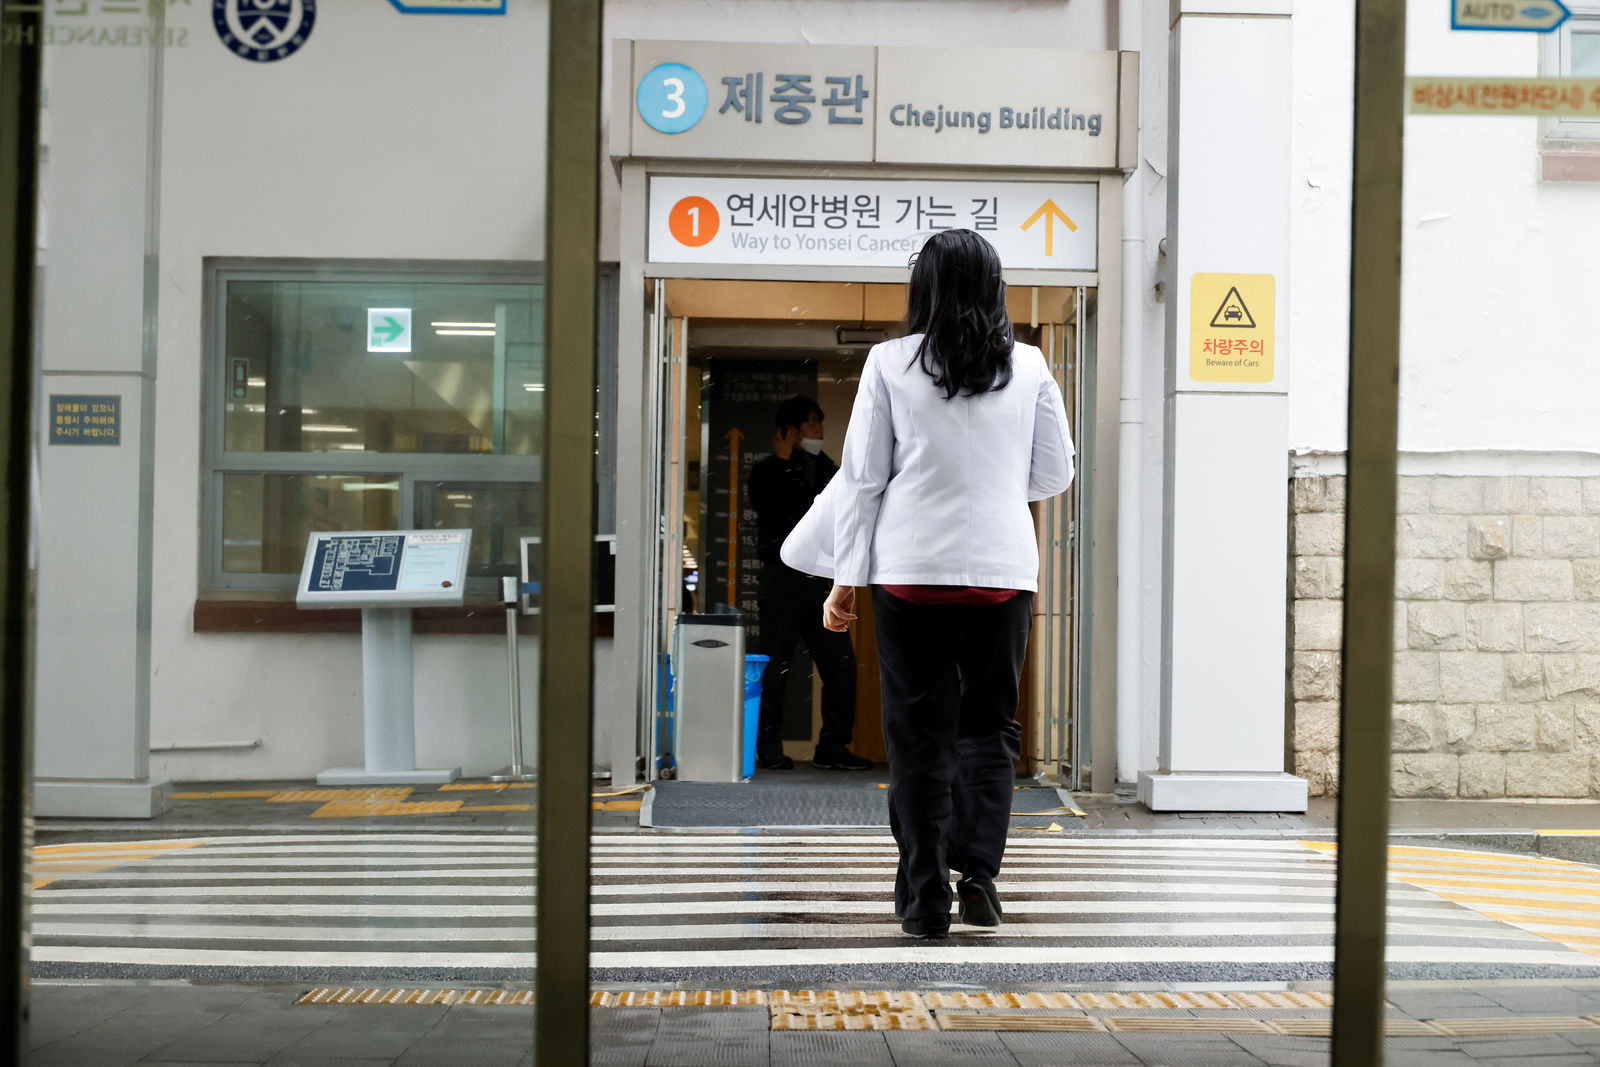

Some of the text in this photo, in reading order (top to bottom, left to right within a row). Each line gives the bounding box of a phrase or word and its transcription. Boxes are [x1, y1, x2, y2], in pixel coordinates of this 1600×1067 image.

[1462, 4, 1514, 21] AUTO
[661, 72, 869, 125] 3 제중관
[889, 103, 1103, 137] Chejung Building
[687, 193, 998, 238] 1 연세암병원 가는 길
[731, 231, 768, 254] Way
[773, 234, 792, 250] to
[795, 232, 852, 252] Yonsei
[857, 234, 916, 252] Cancer
[1202, 338, 1264, 356] 차량주의
[1206, 358, 1259, 367] Beware of Cars
